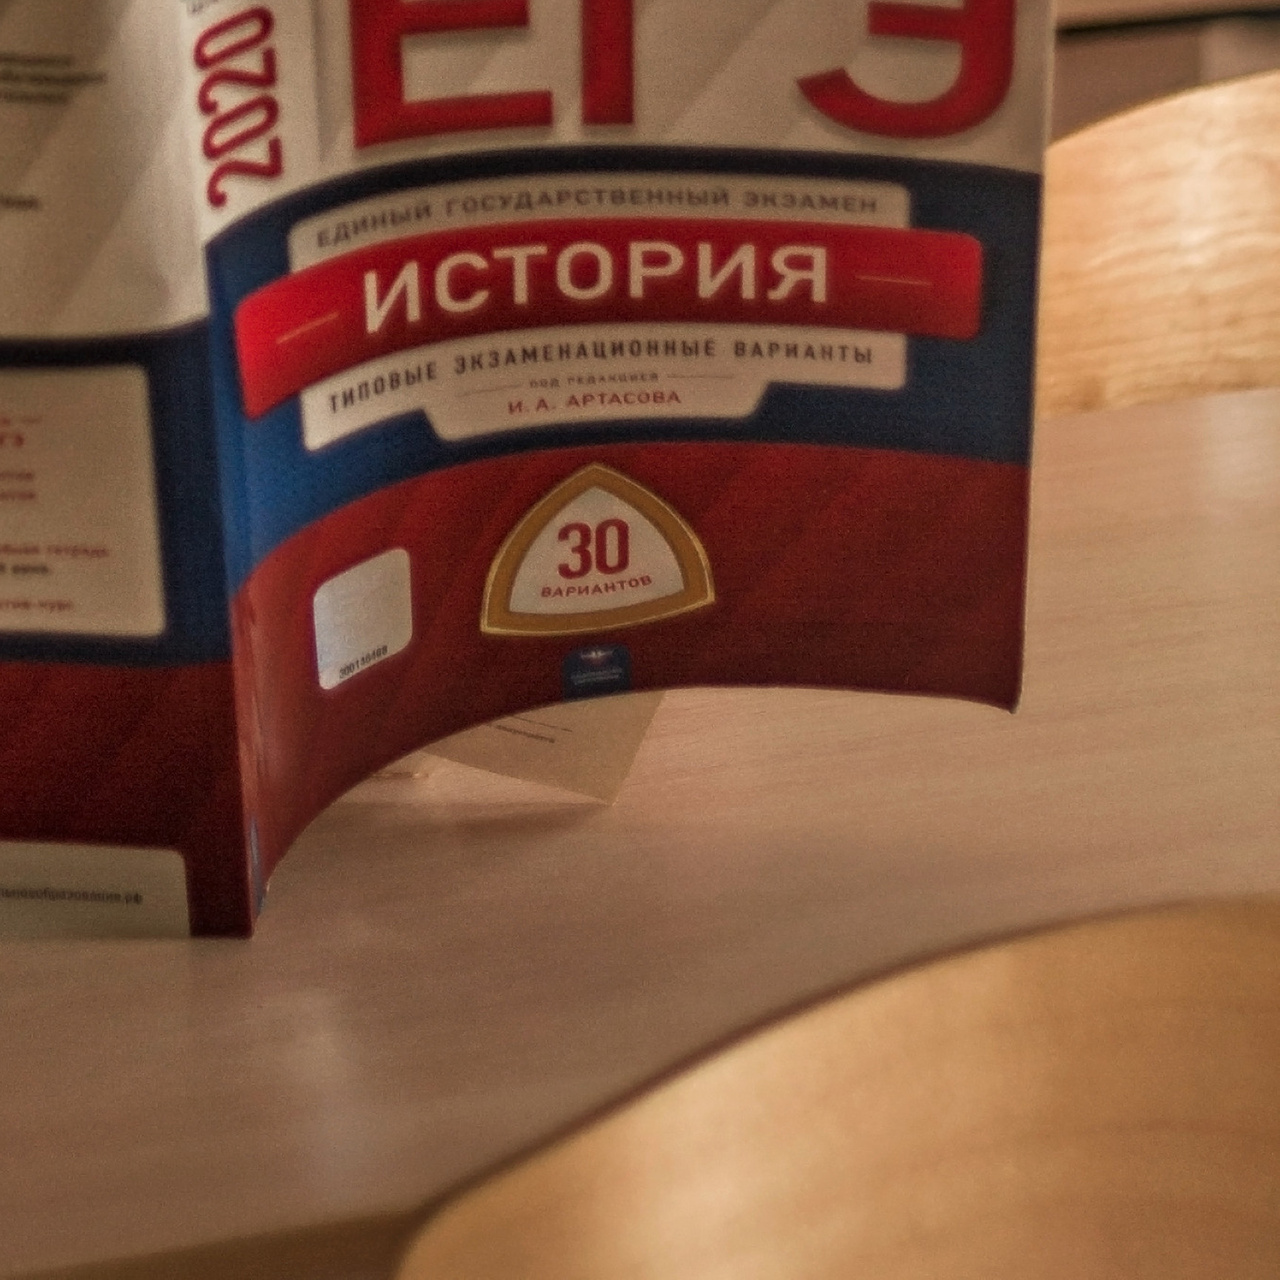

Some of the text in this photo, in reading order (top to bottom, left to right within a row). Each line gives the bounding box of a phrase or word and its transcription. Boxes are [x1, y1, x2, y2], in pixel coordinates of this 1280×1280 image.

[193, 7, 284, 209] 2020
[317, 187, 878, 249] ЕДИНЫЙ ГОСУДАРСТВЕННЫЙ ЭКЗАМЕН
[362, 241, 829, 334] ИСТОРИЯ
[328, 339, 874, 415] ТИПОВЫЕ ЭКЗАМЕНАЦИОННЫЕ ВАРИАНТЫ
[508, 390, 682, 416] И. А. АРТАСОВА
[557, 519, 629, 579] 30
[540, 574, 652, 599] ВАРИАНТОВ
